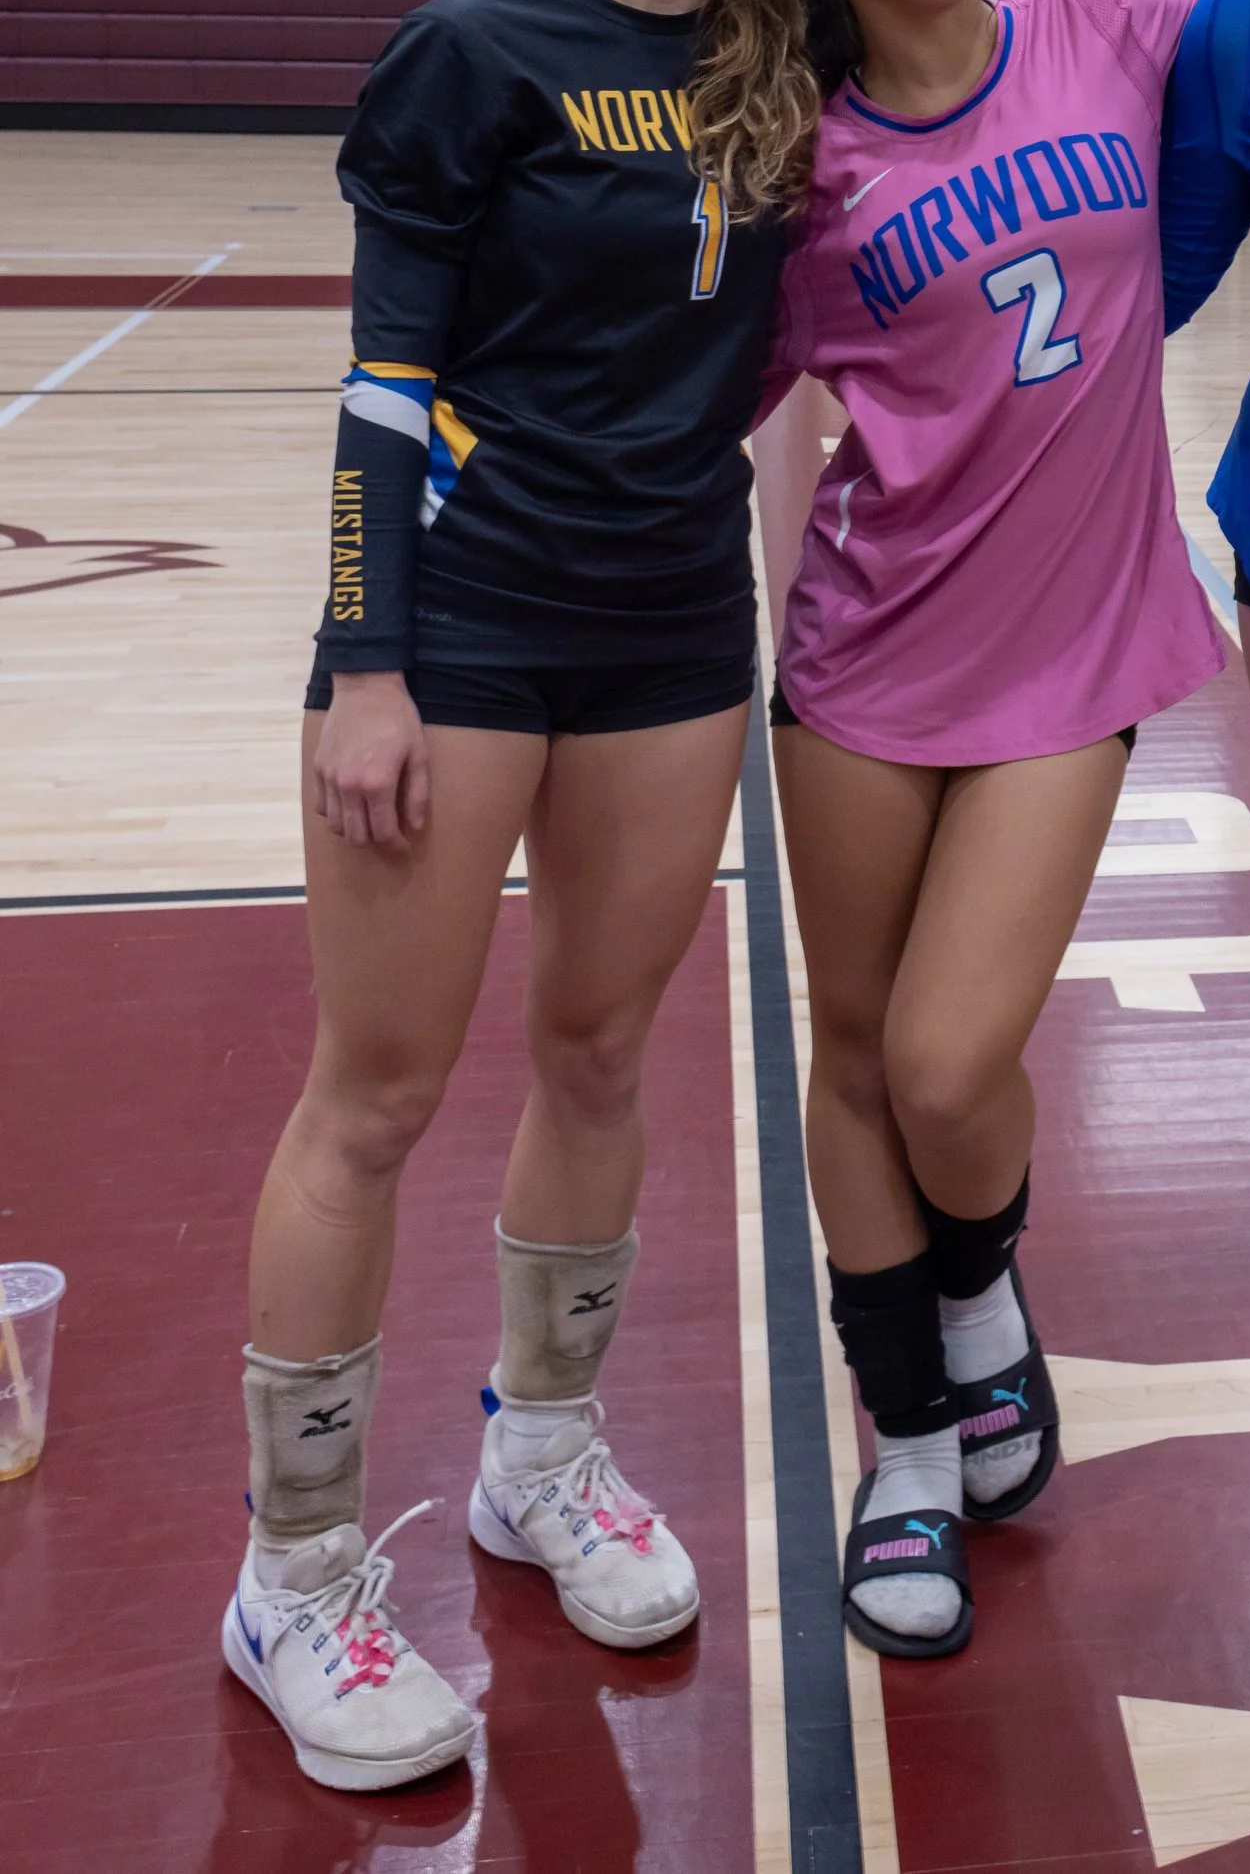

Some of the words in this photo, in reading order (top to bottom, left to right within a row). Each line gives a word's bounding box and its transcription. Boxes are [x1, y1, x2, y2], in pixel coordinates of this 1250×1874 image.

[690, 172, 730, 301] 1
[849, 132, 1149, 332] NORWOOD
[980, 247, 1083, 388] 2
[332, 469, 364, 622] MUSTANGS
[863, 1536, 929, 1564] PUMA
